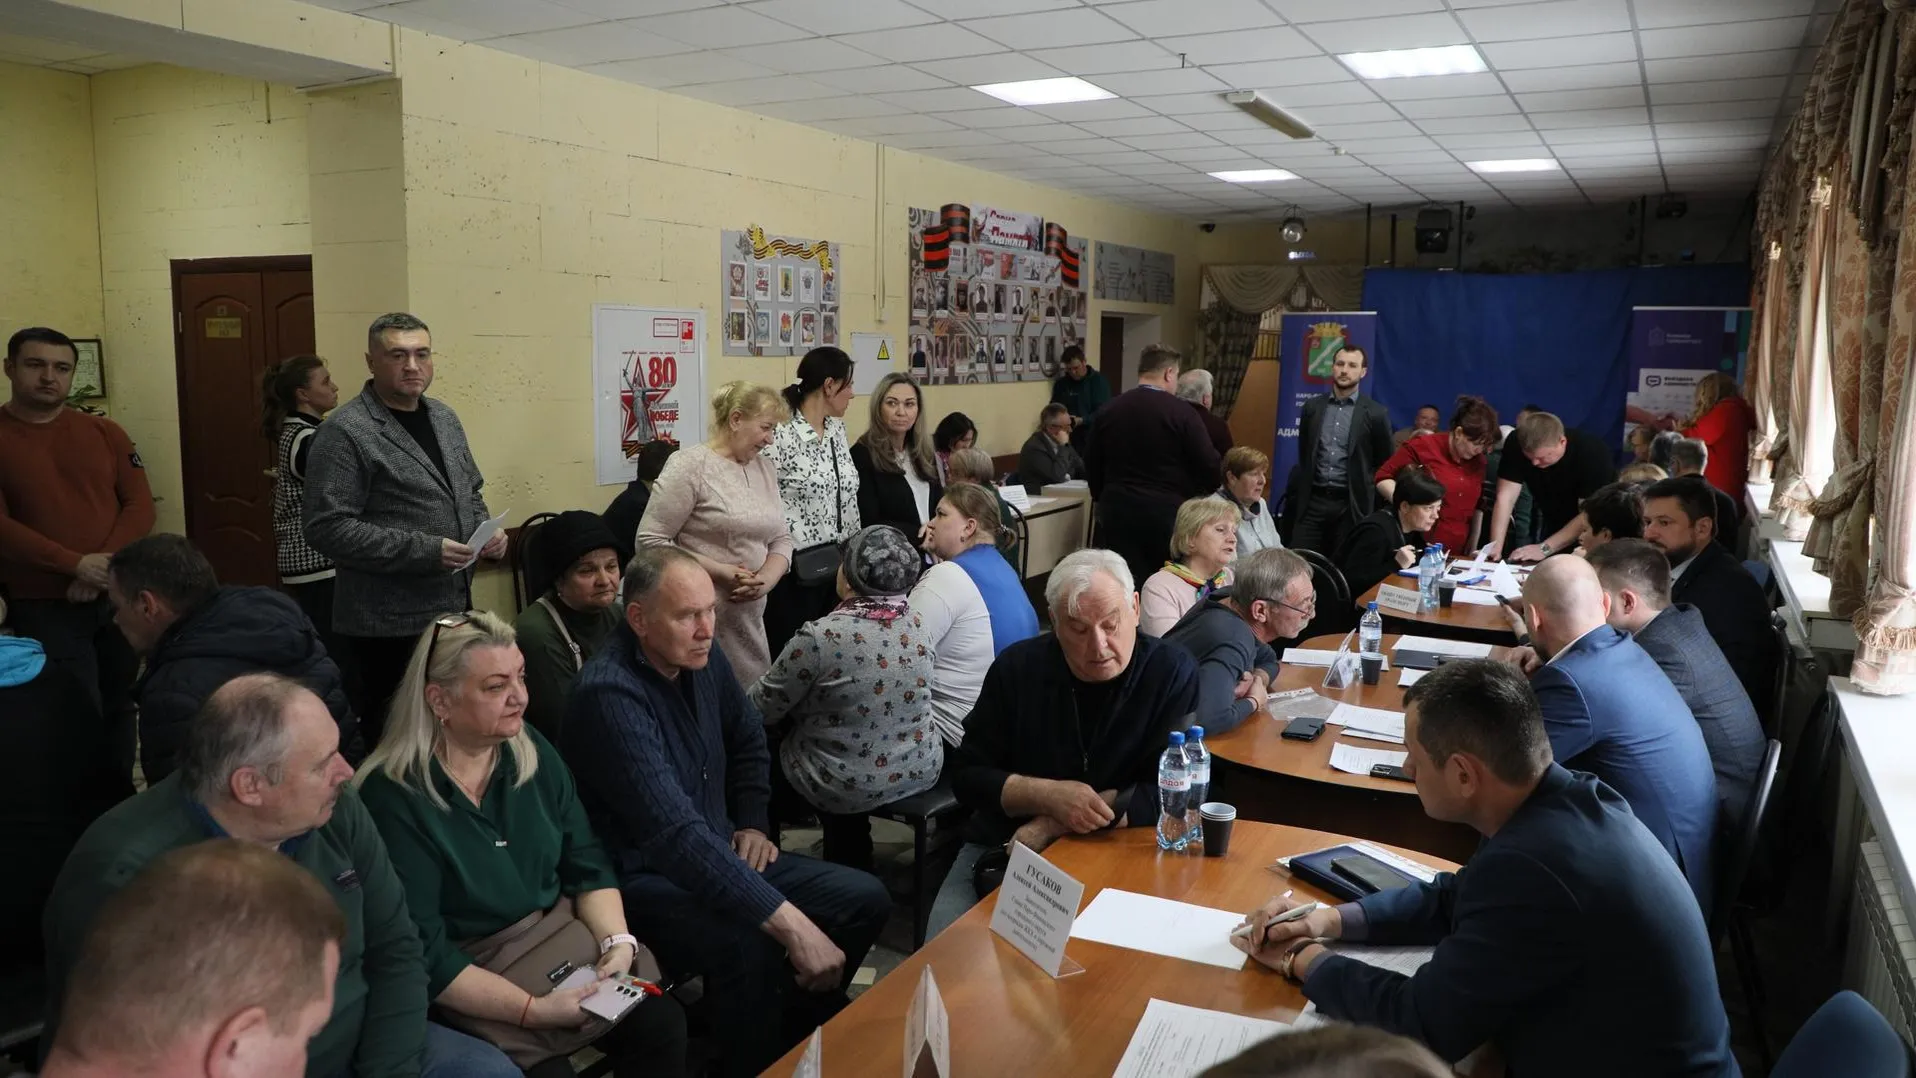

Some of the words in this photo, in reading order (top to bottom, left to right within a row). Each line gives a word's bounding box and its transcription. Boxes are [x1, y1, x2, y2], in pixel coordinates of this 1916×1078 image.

[648, 356, 677, 388] 80
[1012, 871, 1031, 888] Алексей
[1032, 885, 1069, 915] Александрович
[1026, 864, 1062, 895] ГУСАКОВ
